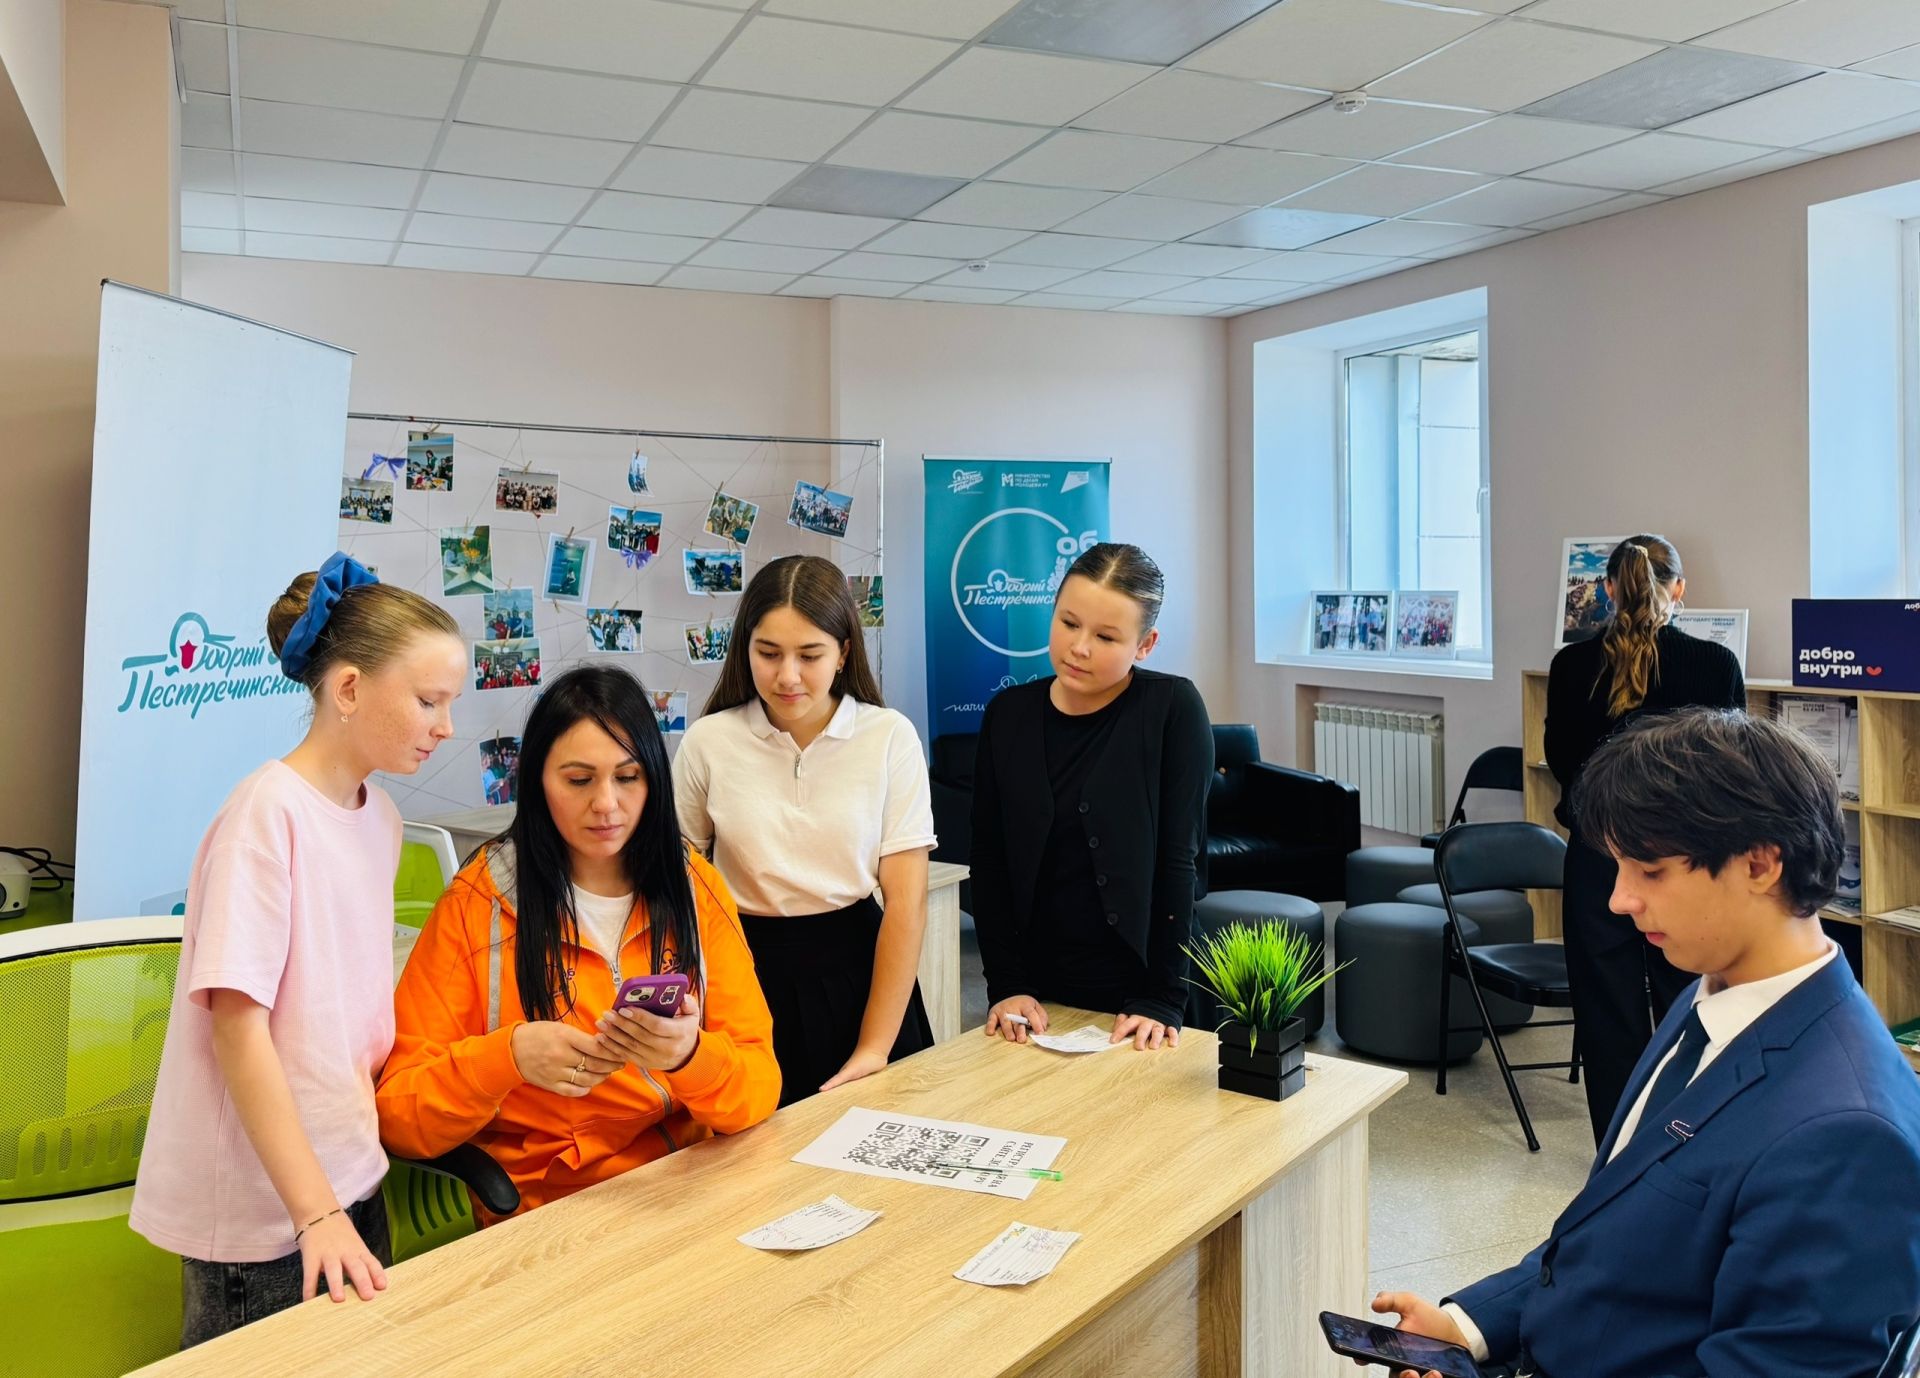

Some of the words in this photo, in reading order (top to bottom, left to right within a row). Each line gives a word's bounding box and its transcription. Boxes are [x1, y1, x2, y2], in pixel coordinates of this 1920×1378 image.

[963, 584, 1056, 610] Пестречинс
[1799, 646, 1855, 664] добро
[1800, 663, 1862, 678] внутри
